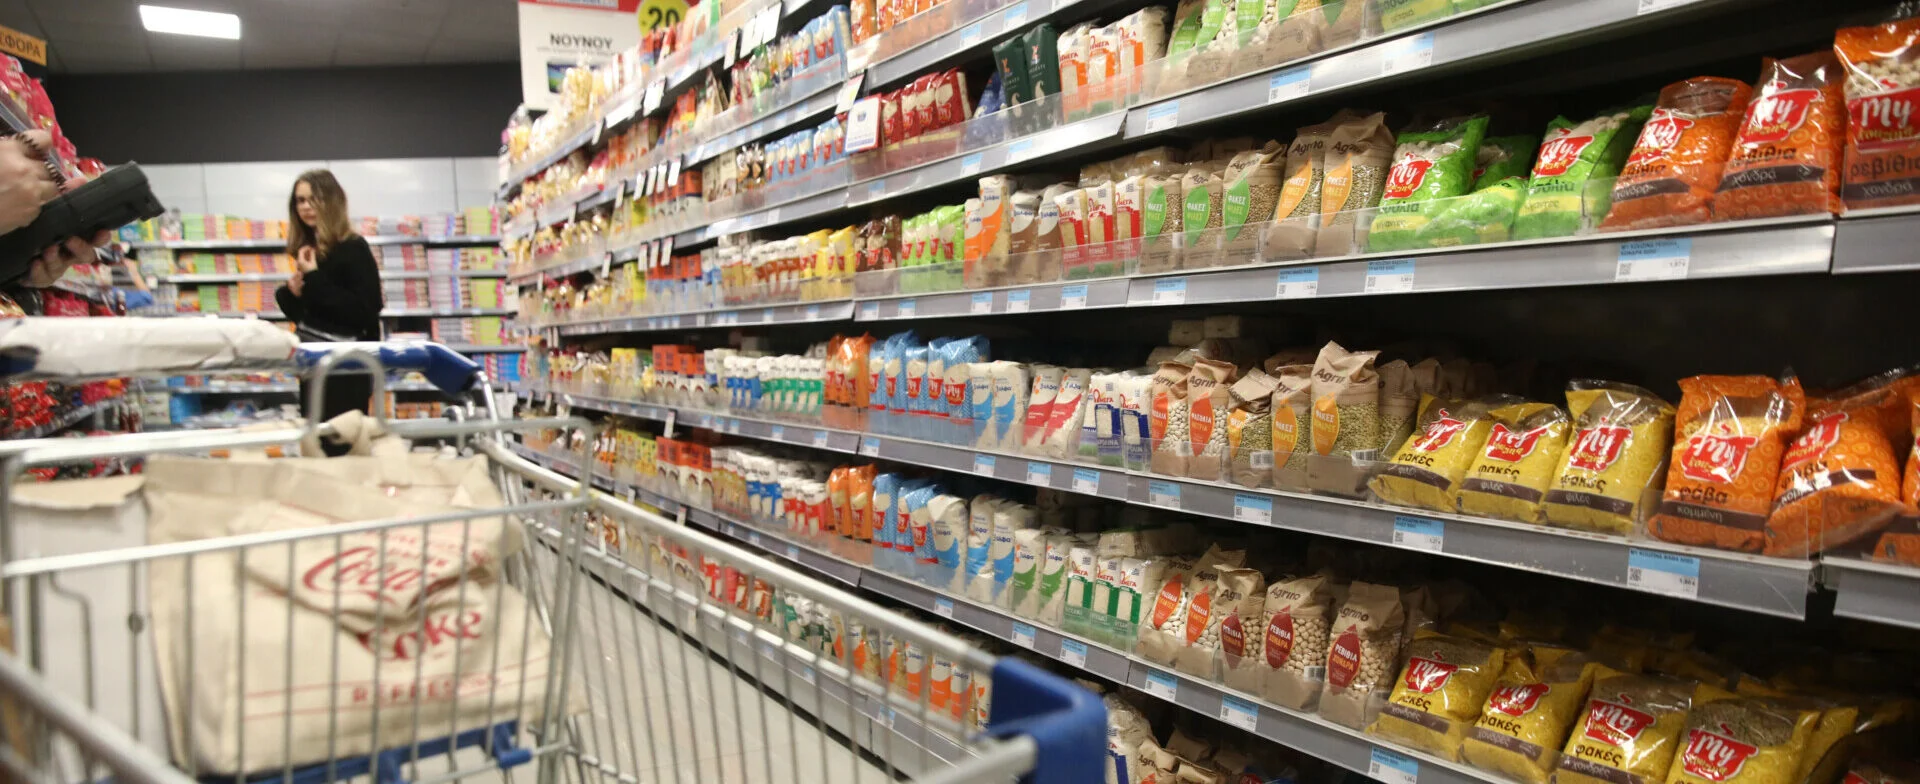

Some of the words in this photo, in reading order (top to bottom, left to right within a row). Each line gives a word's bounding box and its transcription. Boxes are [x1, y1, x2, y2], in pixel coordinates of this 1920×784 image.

[551, 34, 613, 49] ΝΟΥΝΟΥ
[1147, 202, 1164, 212] ΦΑΚΕΣ
[1186, 202, 1207, 212] ΦΑΚΕΣ
[1228, 195, 1247, 206] ΦΑΚΕΣ
[1190, 376, 1217, 388] Agrin
[1269, 587, 1301, 601] Agrino
[1270, 624, 1291, 641] ΡΕΒΙΘΙΑ
[1334, 643, 1358, 663] ΡΕΒΙΘΙΑ
[1576, 744, 1623, 768] φακές
[1693, 734, 1735, 768] My
